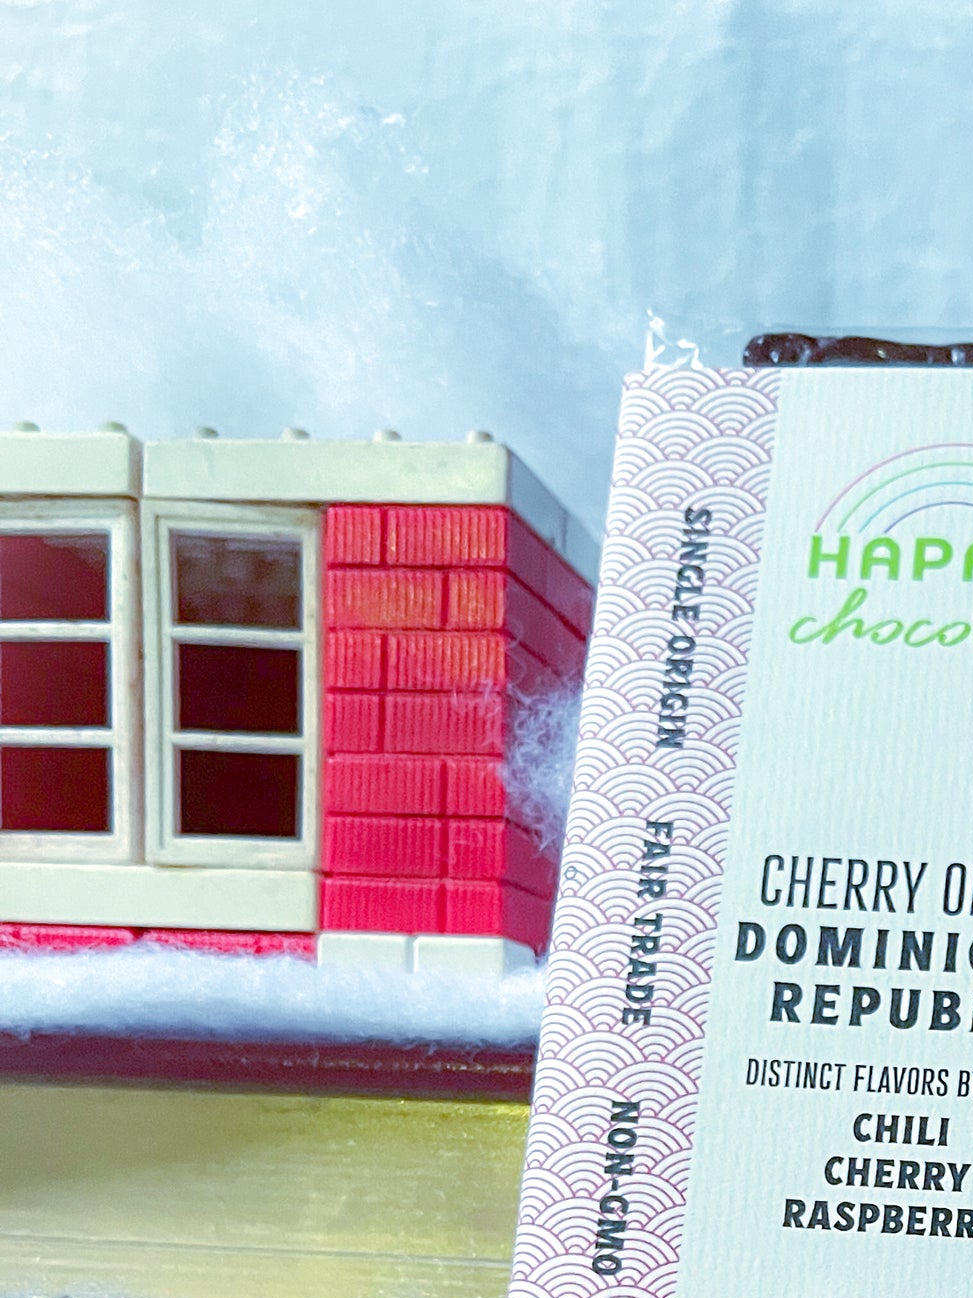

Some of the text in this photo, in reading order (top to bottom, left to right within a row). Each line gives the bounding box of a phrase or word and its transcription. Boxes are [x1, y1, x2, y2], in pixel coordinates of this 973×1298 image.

[656, 506, 713, 749] SINGLE ORIGIN
[760, 854, 929, 914] CHERRY
[622, 820, 673, 1026] FAIR TRADE
[745, 1058, 847, 1091] DISTINCT
[853, 1064, 949, 1097] FLAVORS
[852, 1112, 950, 1147] CHILI
[592, 1100, 641, 1276] NON-GMO
[824, 1155, 972, 1193] CHERRY
